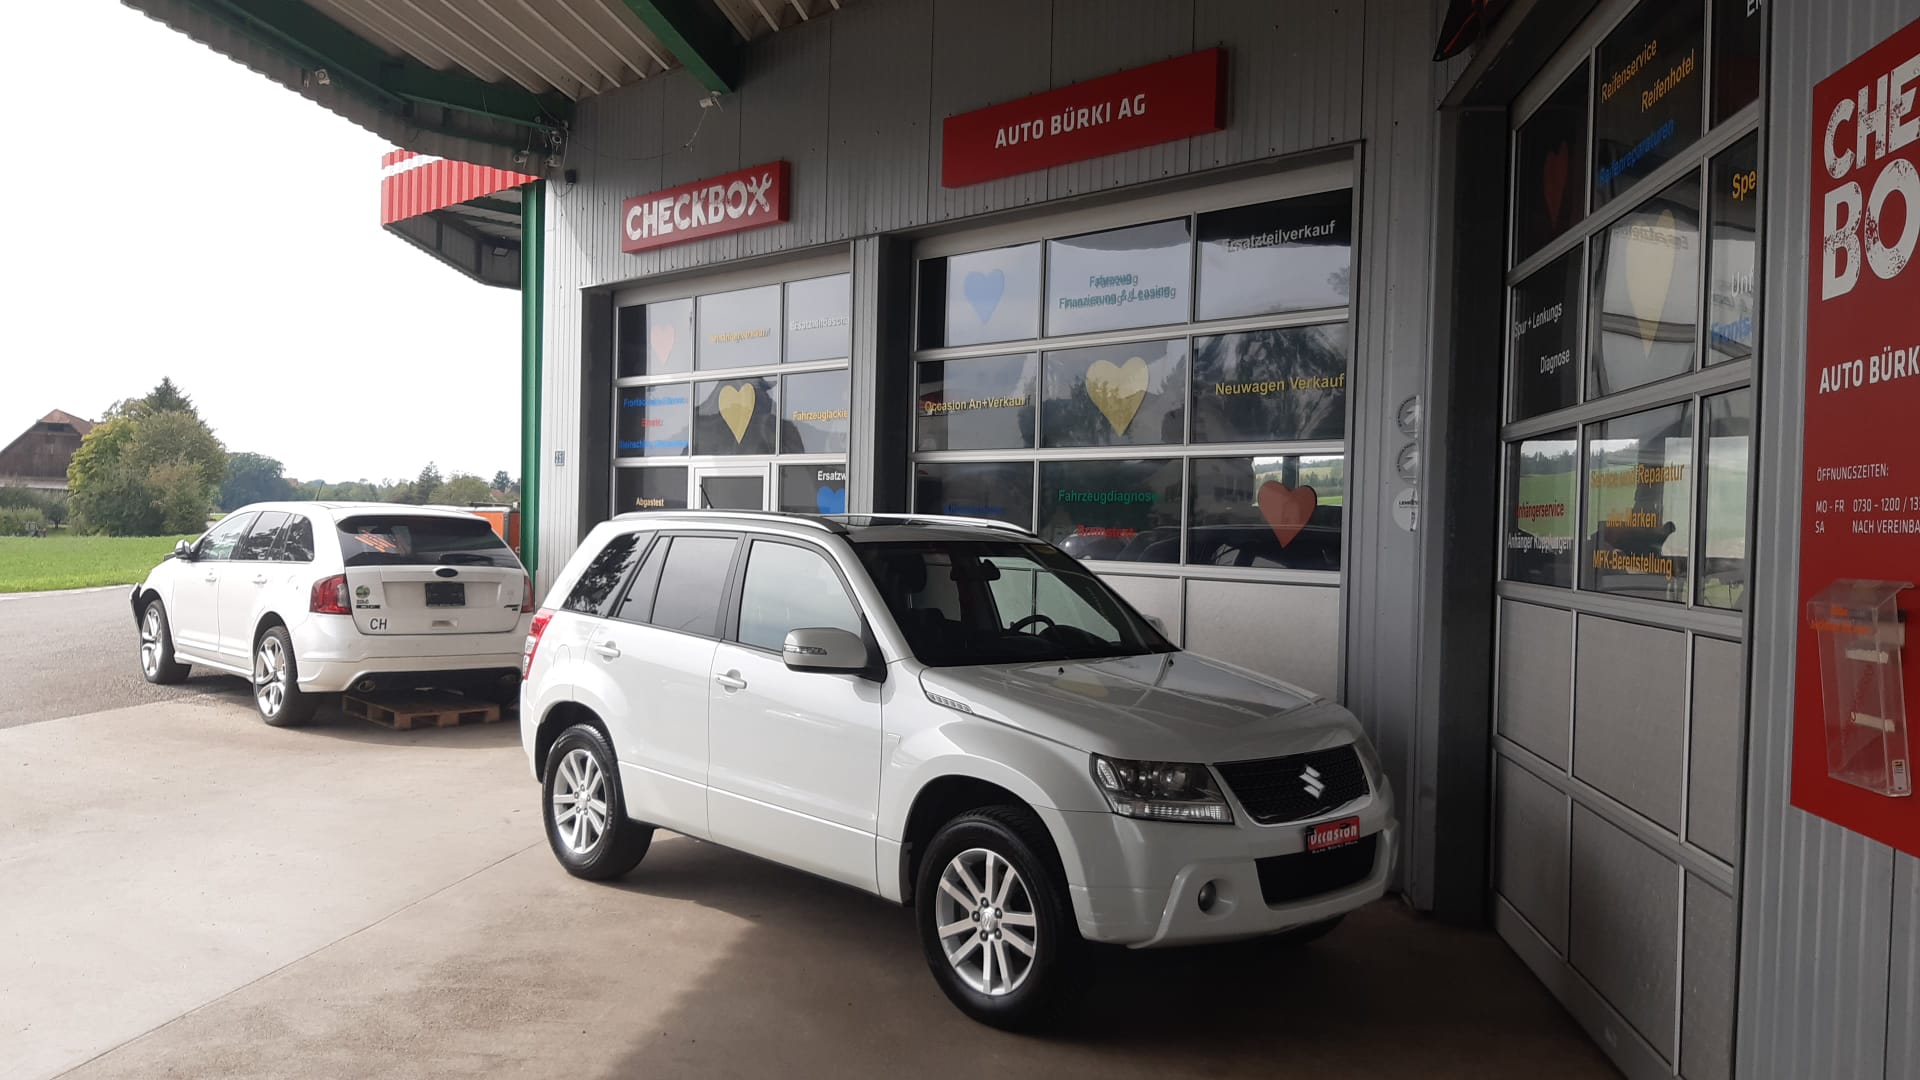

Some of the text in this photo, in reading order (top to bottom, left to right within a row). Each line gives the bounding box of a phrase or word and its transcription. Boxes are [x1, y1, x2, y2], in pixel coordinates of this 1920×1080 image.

[1601, 39, 1657, 104] Reifenservice
[1641, 48, 1695, 113] Reifenhotel
[994, 93, 1147, 150] AUTO BÜRKI AG
[1823, 54, 1920, 179] CHE
[1732, 170, 1756, 202] Spe
[625, 172, 773, 241] CHECKBOX
[1223, 219, 1336, 252] Ersatzteilverkauf
[1822, 158, 1920, 301] BO
[1532, 303, 1563, 329] Lenkungs
[1539, 348, 1571, 375] Diagnose
[1819, 344, 1920, 394] AUTO BÜRK
[1215, 373, 1345, 396] Neuwagen Verkauf
[924, 398, 966, 412] Occasion
[1637, 461, 1685, 488] Reparatur
[1816, 463, 1889, 482] ÖFFNUNGSZEITEN:
[1815, 499, 1828, 513] MO
[1834, 499, 1845, 513] FR
[1853, 498, 1872, 512] 0730
[1881, 497, 1900, 512] 1200
[1815, 520, 1825, 534] SA
[1852, 519, 1874, 534] NACH
[1592, 549, 1674, 581] MFK-Bereitstellung
[369, 617, 388, 631] CH
